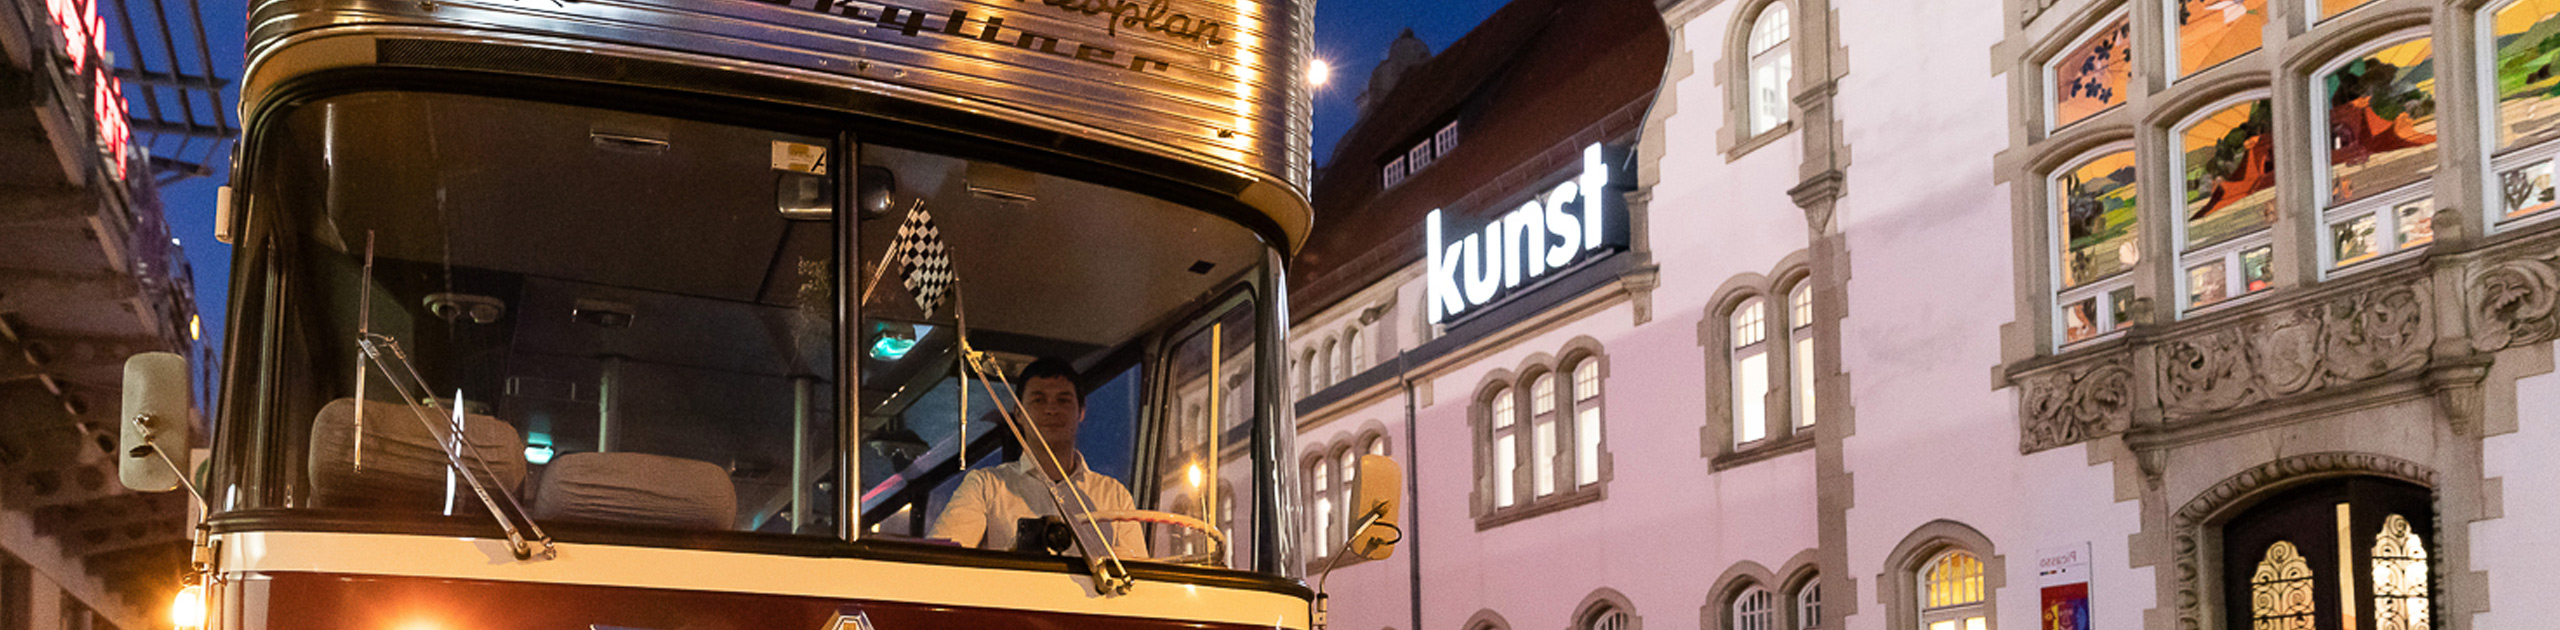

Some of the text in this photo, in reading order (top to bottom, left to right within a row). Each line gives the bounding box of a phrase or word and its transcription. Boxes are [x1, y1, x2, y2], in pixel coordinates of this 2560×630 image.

[768, 0, 1169, 73] kyliner
[1019, 0, 1224, 46] oplan
[1427, 141, 1608, 325] kunst
